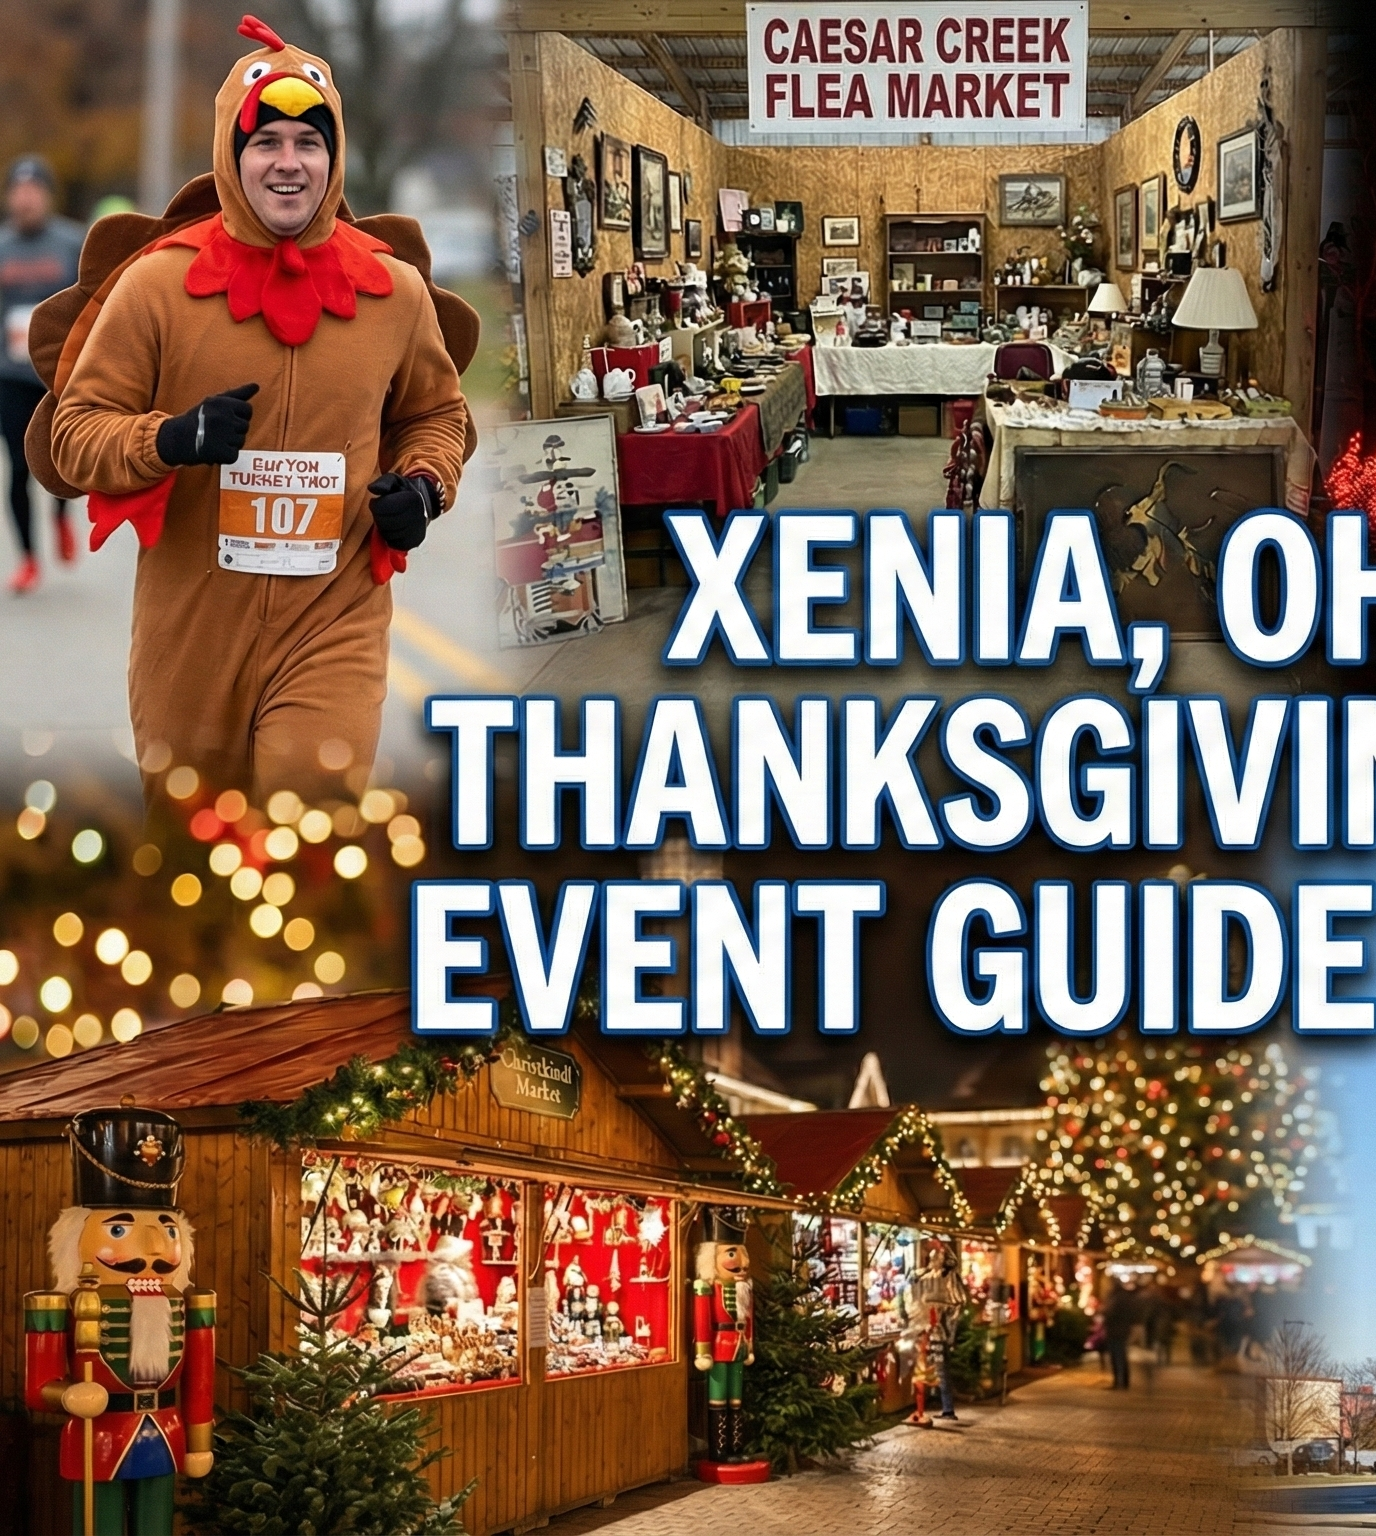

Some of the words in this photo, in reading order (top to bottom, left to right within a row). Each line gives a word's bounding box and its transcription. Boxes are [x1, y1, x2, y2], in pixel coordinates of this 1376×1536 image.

[764, 18, 924, 64] CAESAR
[935, 17, 1071, 64] CREEK
[765, 73, 874, 119] FLEA
[887, 72, 1071, 119] MARKET
[250, 495, 319, 535] 107
